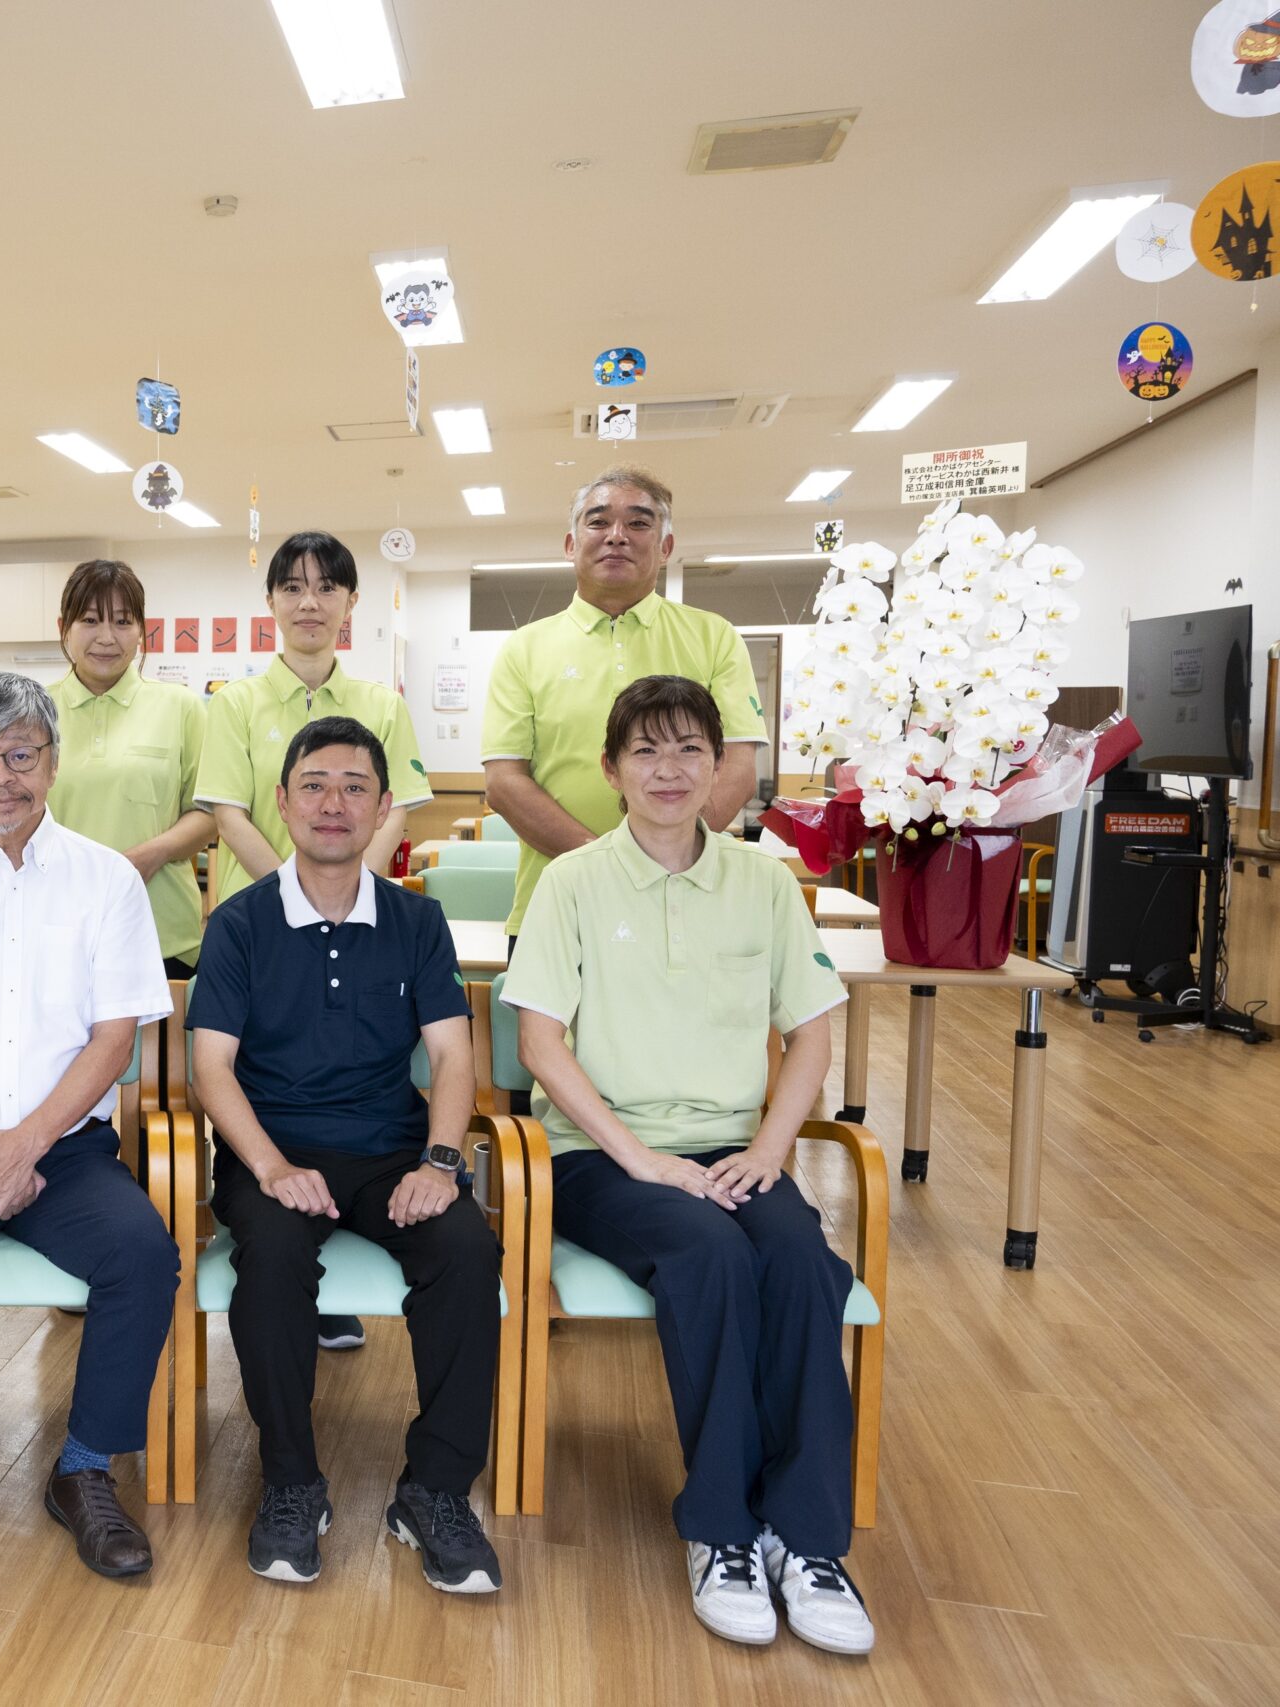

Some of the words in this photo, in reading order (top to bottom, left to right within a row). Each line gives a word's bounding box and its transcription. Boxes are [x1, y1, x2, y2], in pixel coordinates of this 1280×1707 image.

[932, 448, 985, 464] 開所御祝
[904, 459, 1001, 475] 株式会社わかばケアセンター
[908, 467, 1009, 482] デイサービスわかば西新井
[1011, 465, 1020, 473] 様
[905, 477, 985, 493] 足立成和信用金庫
[1109, 816, 1185, 825] FREEDAM
